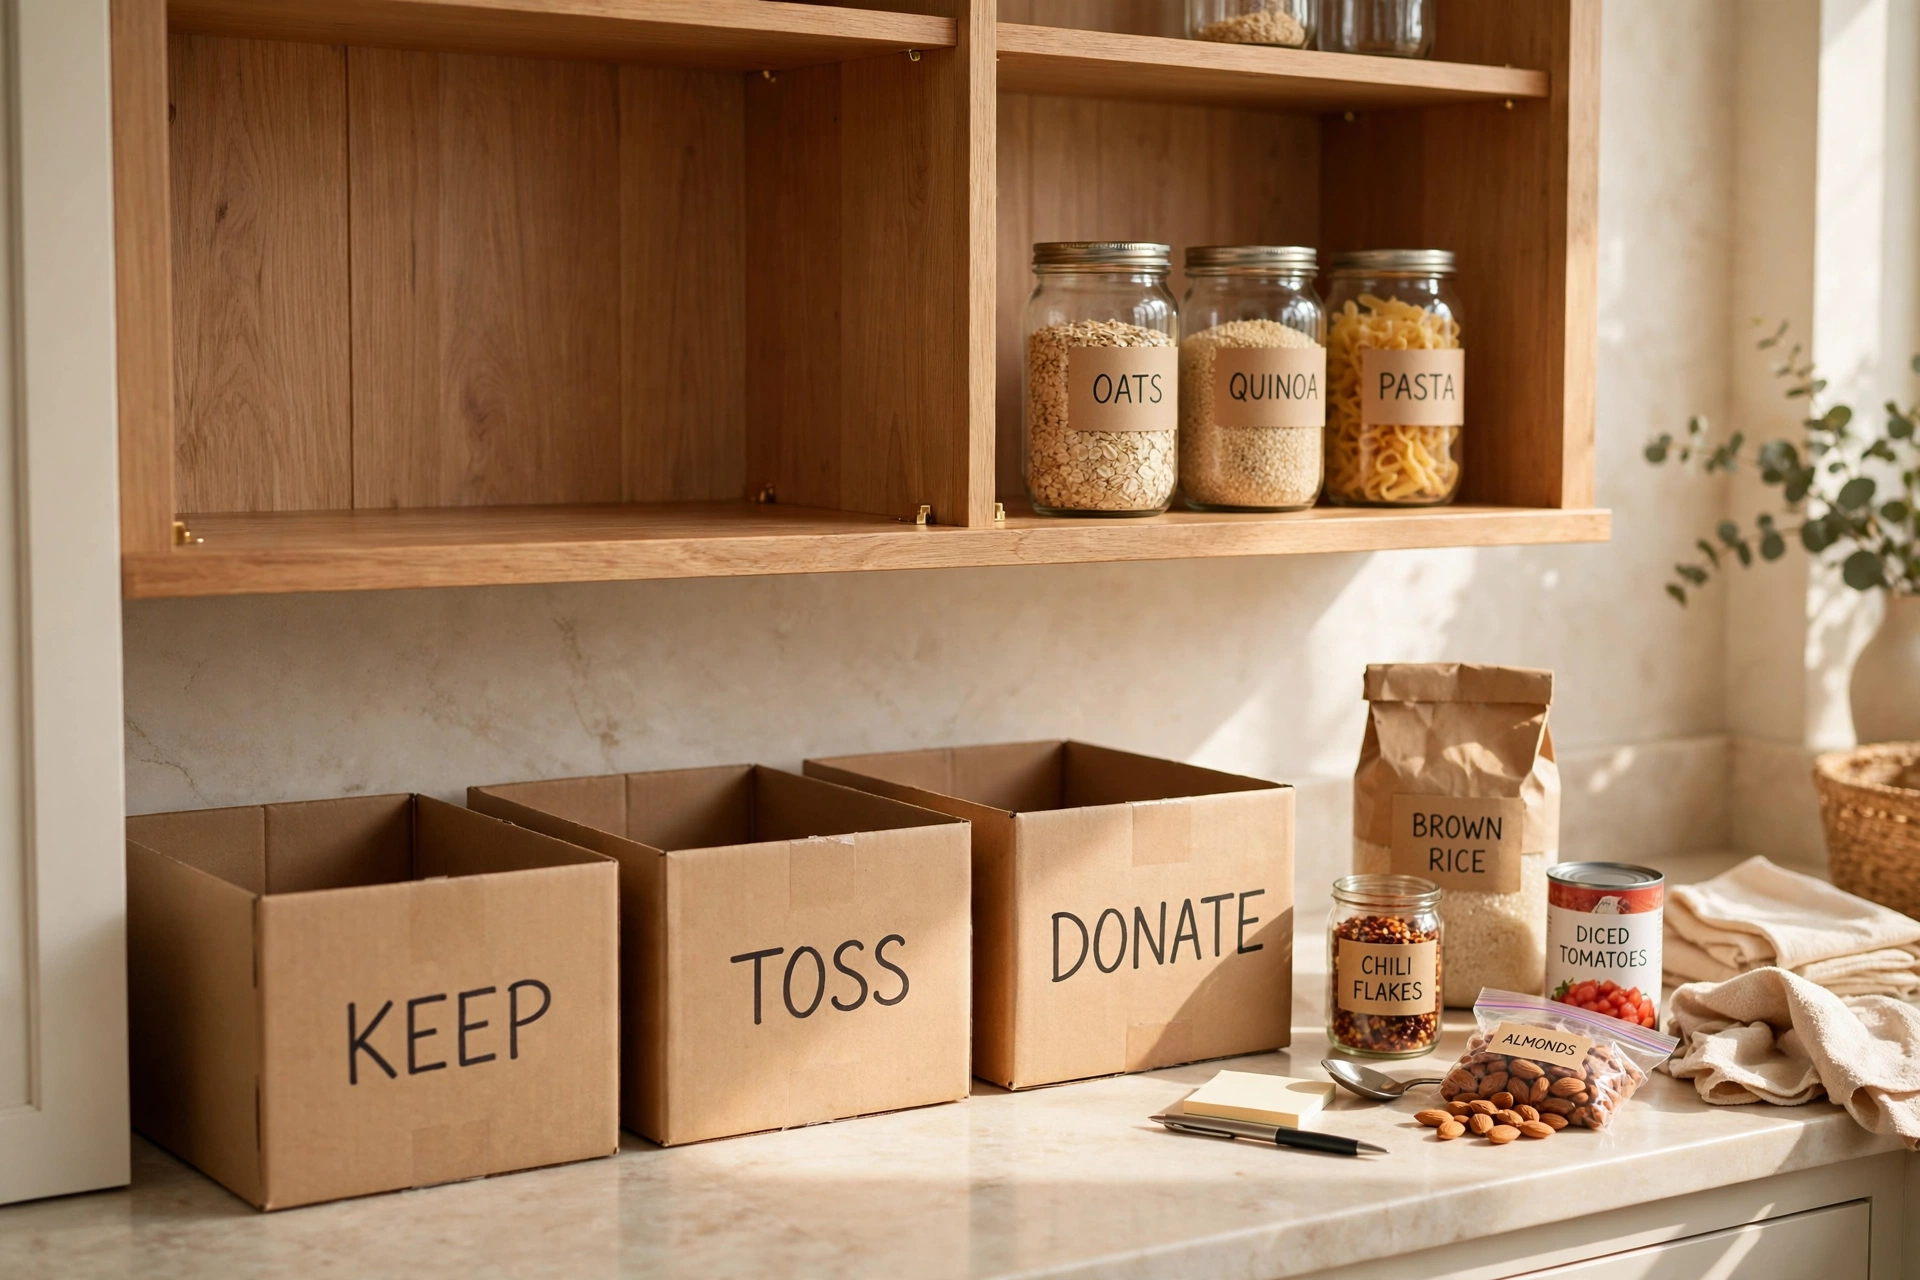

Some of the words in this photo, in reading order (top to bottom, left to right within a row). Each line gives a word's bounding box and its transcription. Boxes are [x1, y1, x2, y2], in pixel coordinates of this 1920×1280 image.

[1092, 373, 1163, 404] OATS
[1229, 371, 1318, 403] QUINOA
[1379, 371, 1456, 400] PASTA
[1412, 812, 1503, 841] BROWN
[1429, 847, 1486, 874] RICE
[1051, 888, 1267, 984] DONATE
[1576, 924, 1630, 945] DICED
[1361, 954, 1412, 976] CHILI
[1559, 944, 1648, 969] TOMATOES
[730, 934, 911, 1026] TOSS
[1353, 979, 1423, 1002] FLAKES
[347, 978, 552, 1086] KEEP
[1501, 1032, 1577, 1057] ALMONDS
